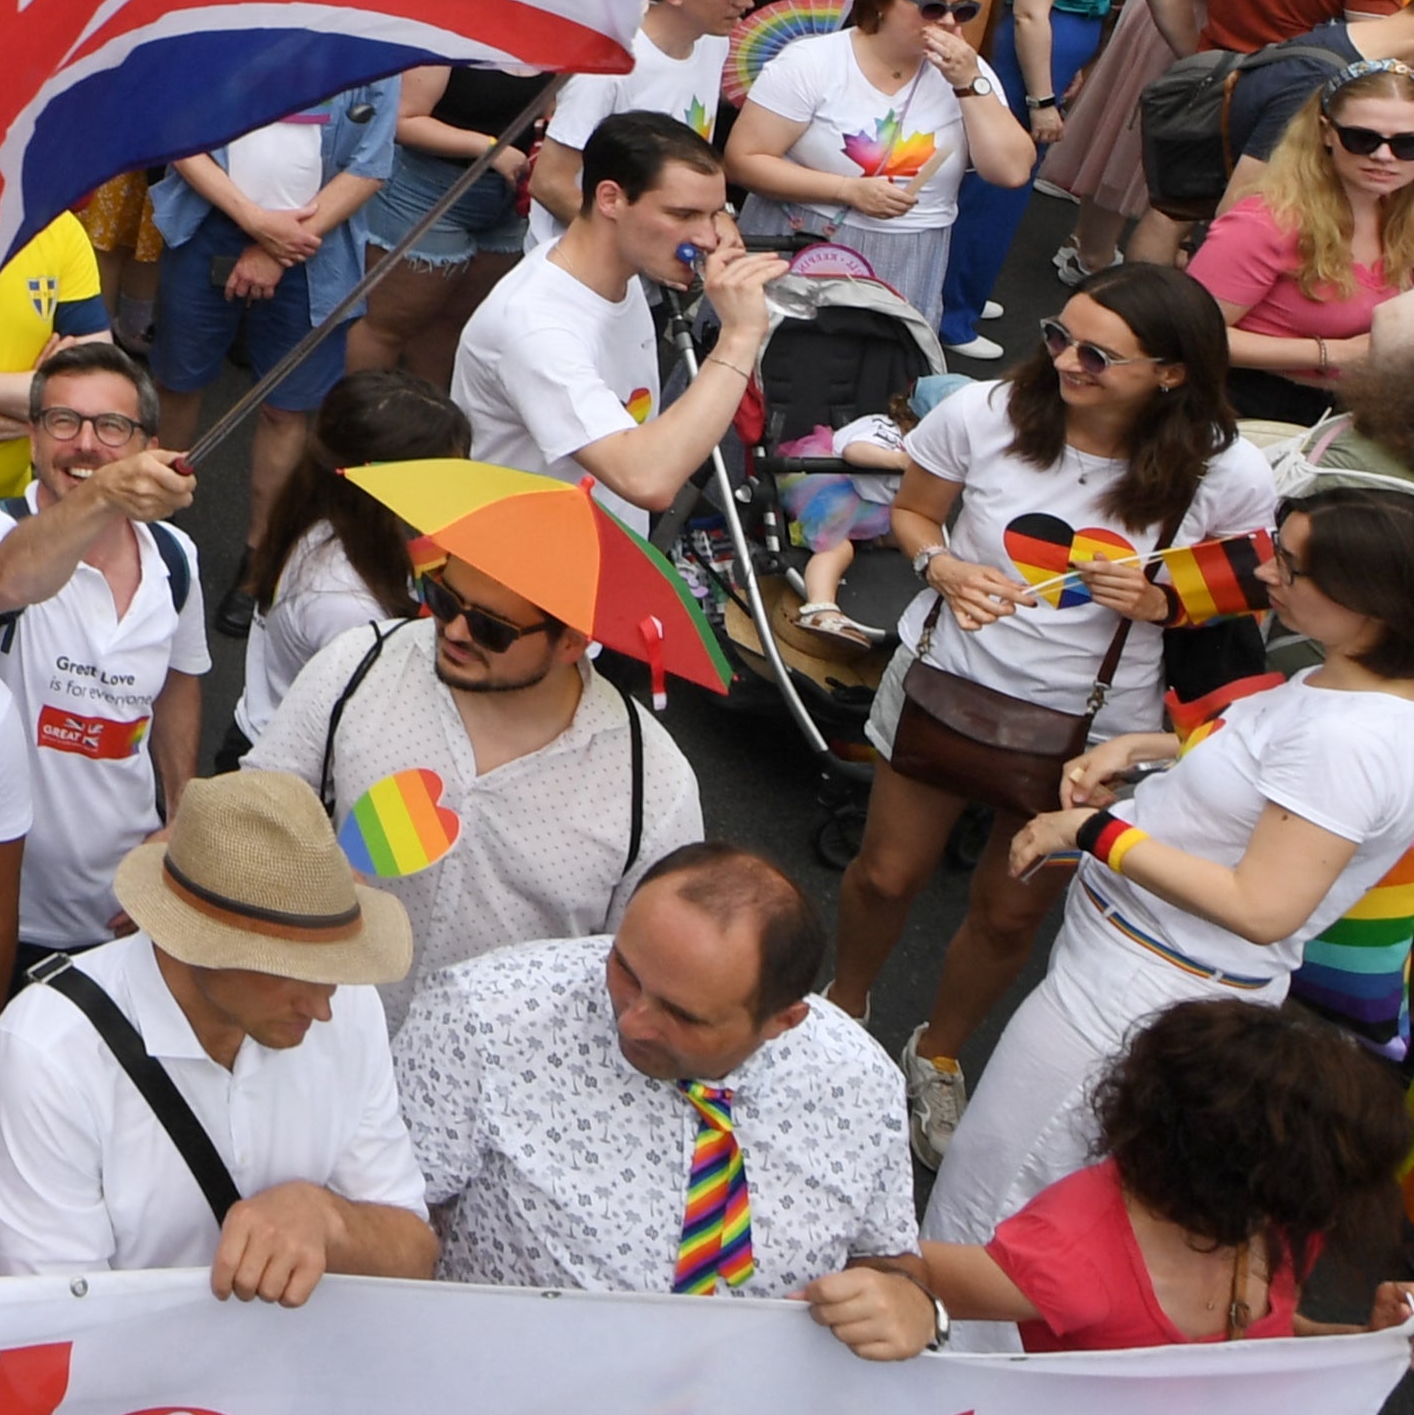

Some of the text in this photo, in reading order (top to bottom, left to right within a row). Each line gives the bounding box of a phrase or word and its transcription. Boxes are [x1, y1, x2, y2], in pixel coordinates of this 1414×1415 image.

[56, 656, 135, 686] Great Love
[50, 676, 62, 691] is
[43, 724, 81, 742] GREAT
